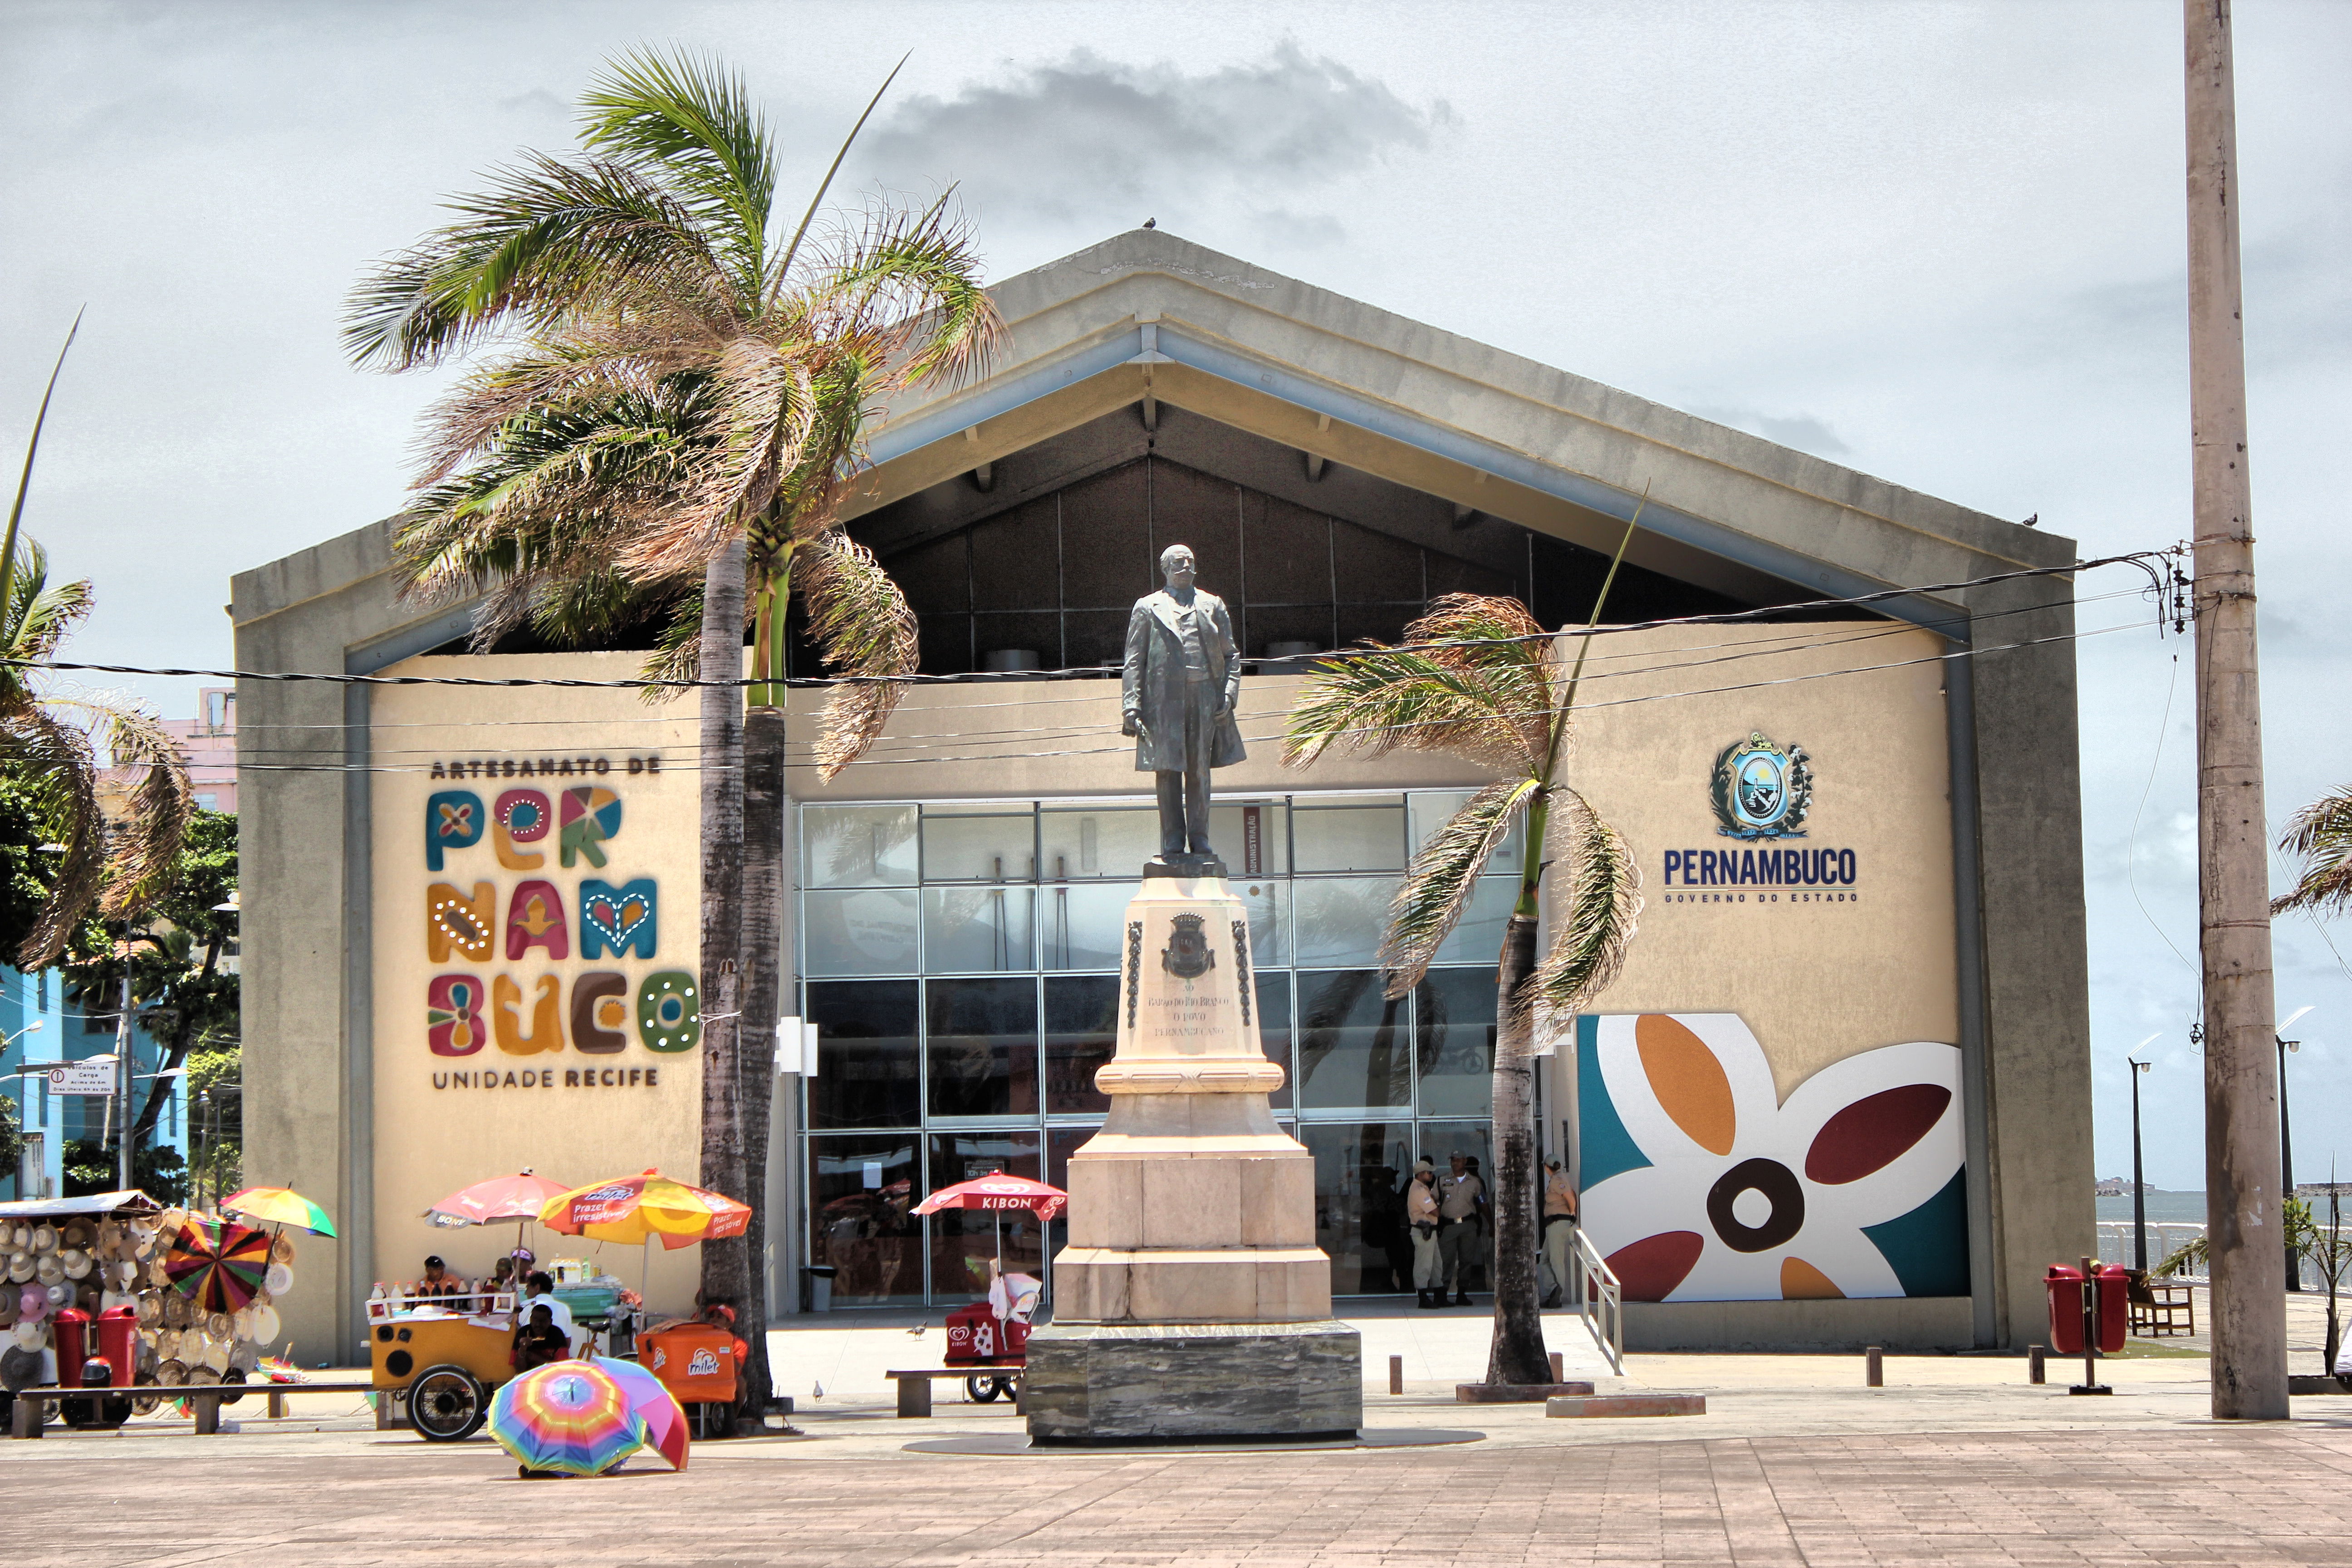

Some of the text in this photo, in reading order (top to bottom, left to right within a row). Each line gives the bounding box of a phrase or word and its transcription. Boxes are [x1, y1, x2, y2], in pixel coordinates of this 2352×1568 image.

[431, 757, 660, 779] ARTESANATO DE
[426, 787, 622, 872] PER
[1665, 849, 1856, 885] PERNAMBUCO
[1665, 894, 1745, 903] GOVERNO
[1791, 894, 1857, 902] ESTADO
[427, 879, 657, 963] NAM
[428, 971, 701, 1057] BUCO
[432, 1069, 657, 1089] UNIDADE RECIFE
[574, 1203, 608, 1214] Prazer
[982, 1197, 1031, 1208] KIBON
[436, 1215, 467, 1226] SONY
[714, 1213, 734, 1226] Prazer
[690, 1360, 718, 1373] milet
